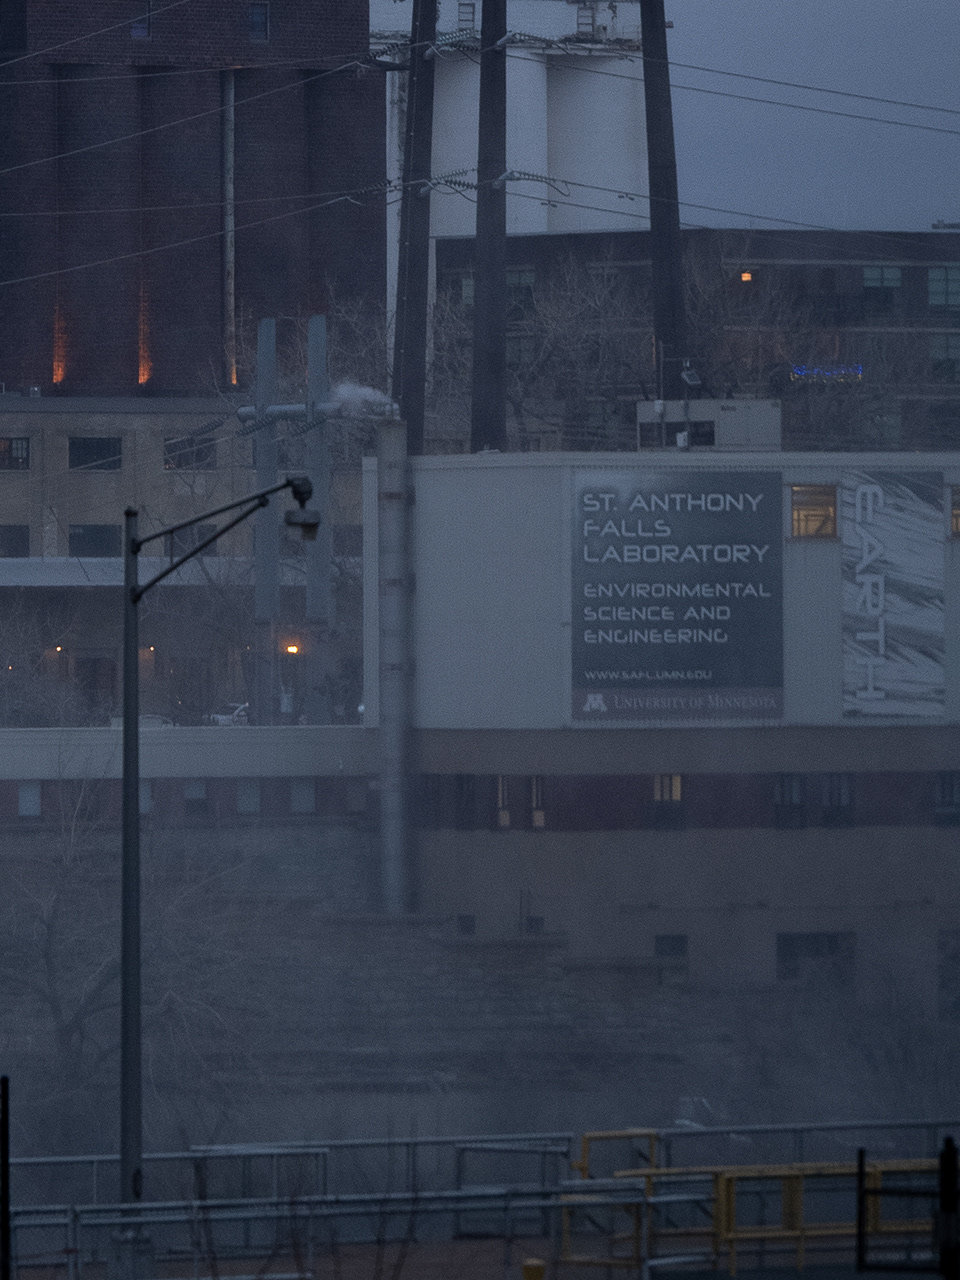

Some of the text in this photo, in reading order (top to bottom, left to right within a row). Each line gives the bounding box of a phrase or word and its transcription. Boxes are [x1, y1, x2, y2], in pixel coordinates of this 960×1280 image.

[583, 493, 764, 512] ST. ANTHONY
[583, 519, 672, 538] FALLS
[583, 544, 770, 564] LABORATORY
[583, 582, 772, 598] ENVIRONMENTAL
[855, 483, 886, 699] EARTH
[583, 606, 732, 621] SCIENCE AND
[583, 629, 728, 644] ENGINEERING
